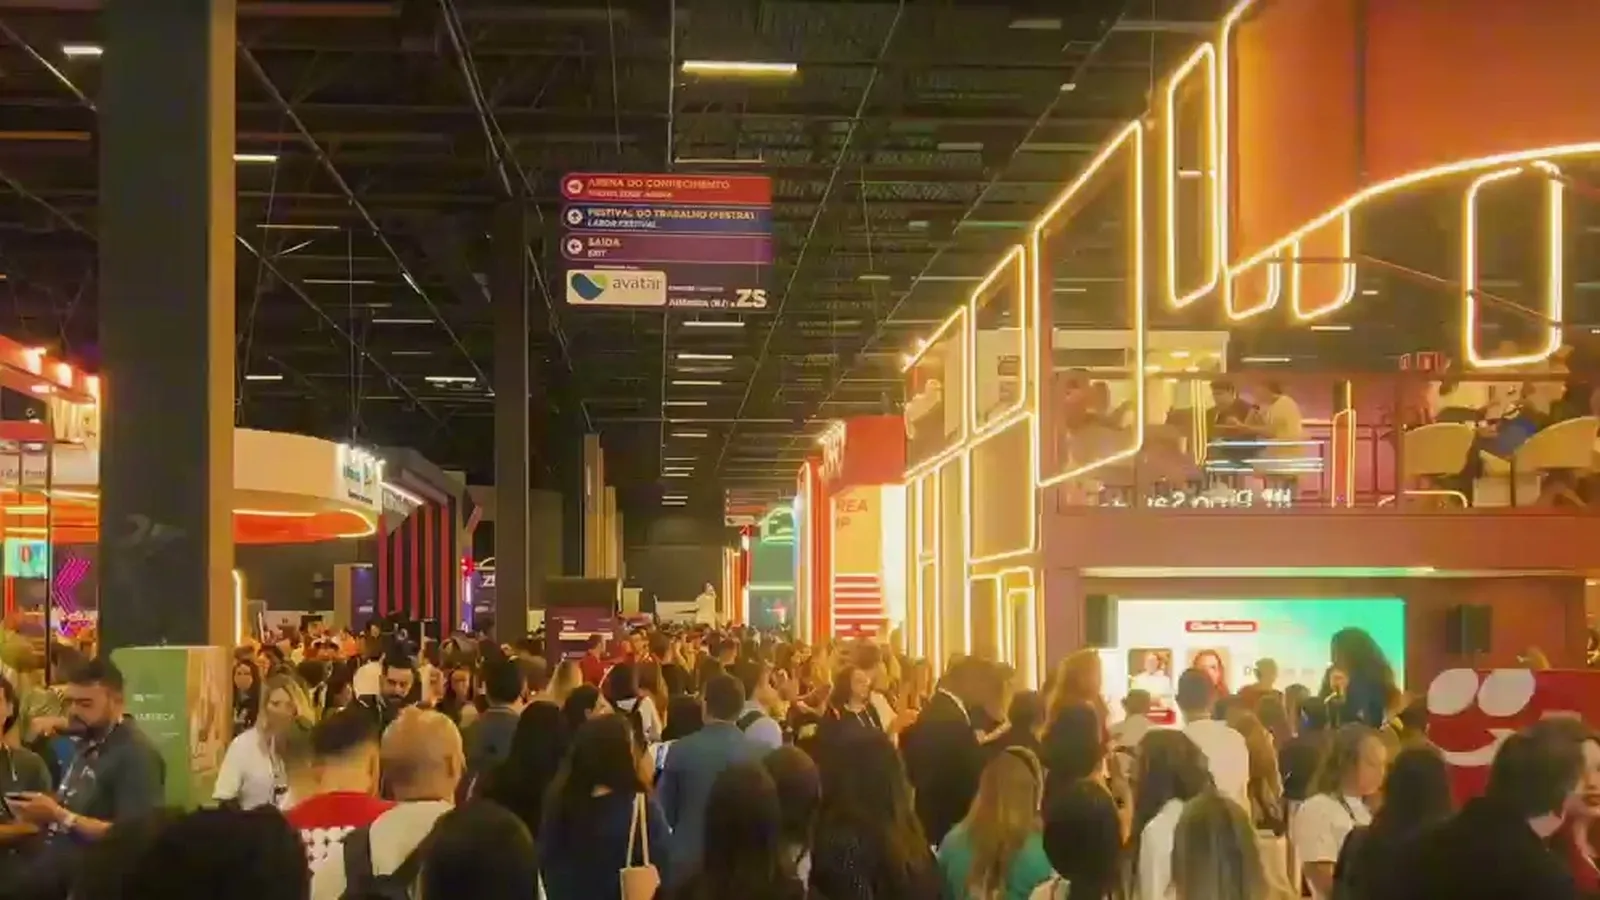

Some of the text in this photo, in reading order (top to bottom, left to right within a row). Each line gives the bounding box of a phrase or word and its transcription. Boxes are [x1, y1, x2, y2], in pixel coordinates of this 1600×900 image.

[627, 179, 643, 188] DO
[636, 209, 652, 218] DO
[612, 277, 662, 290] avatar
